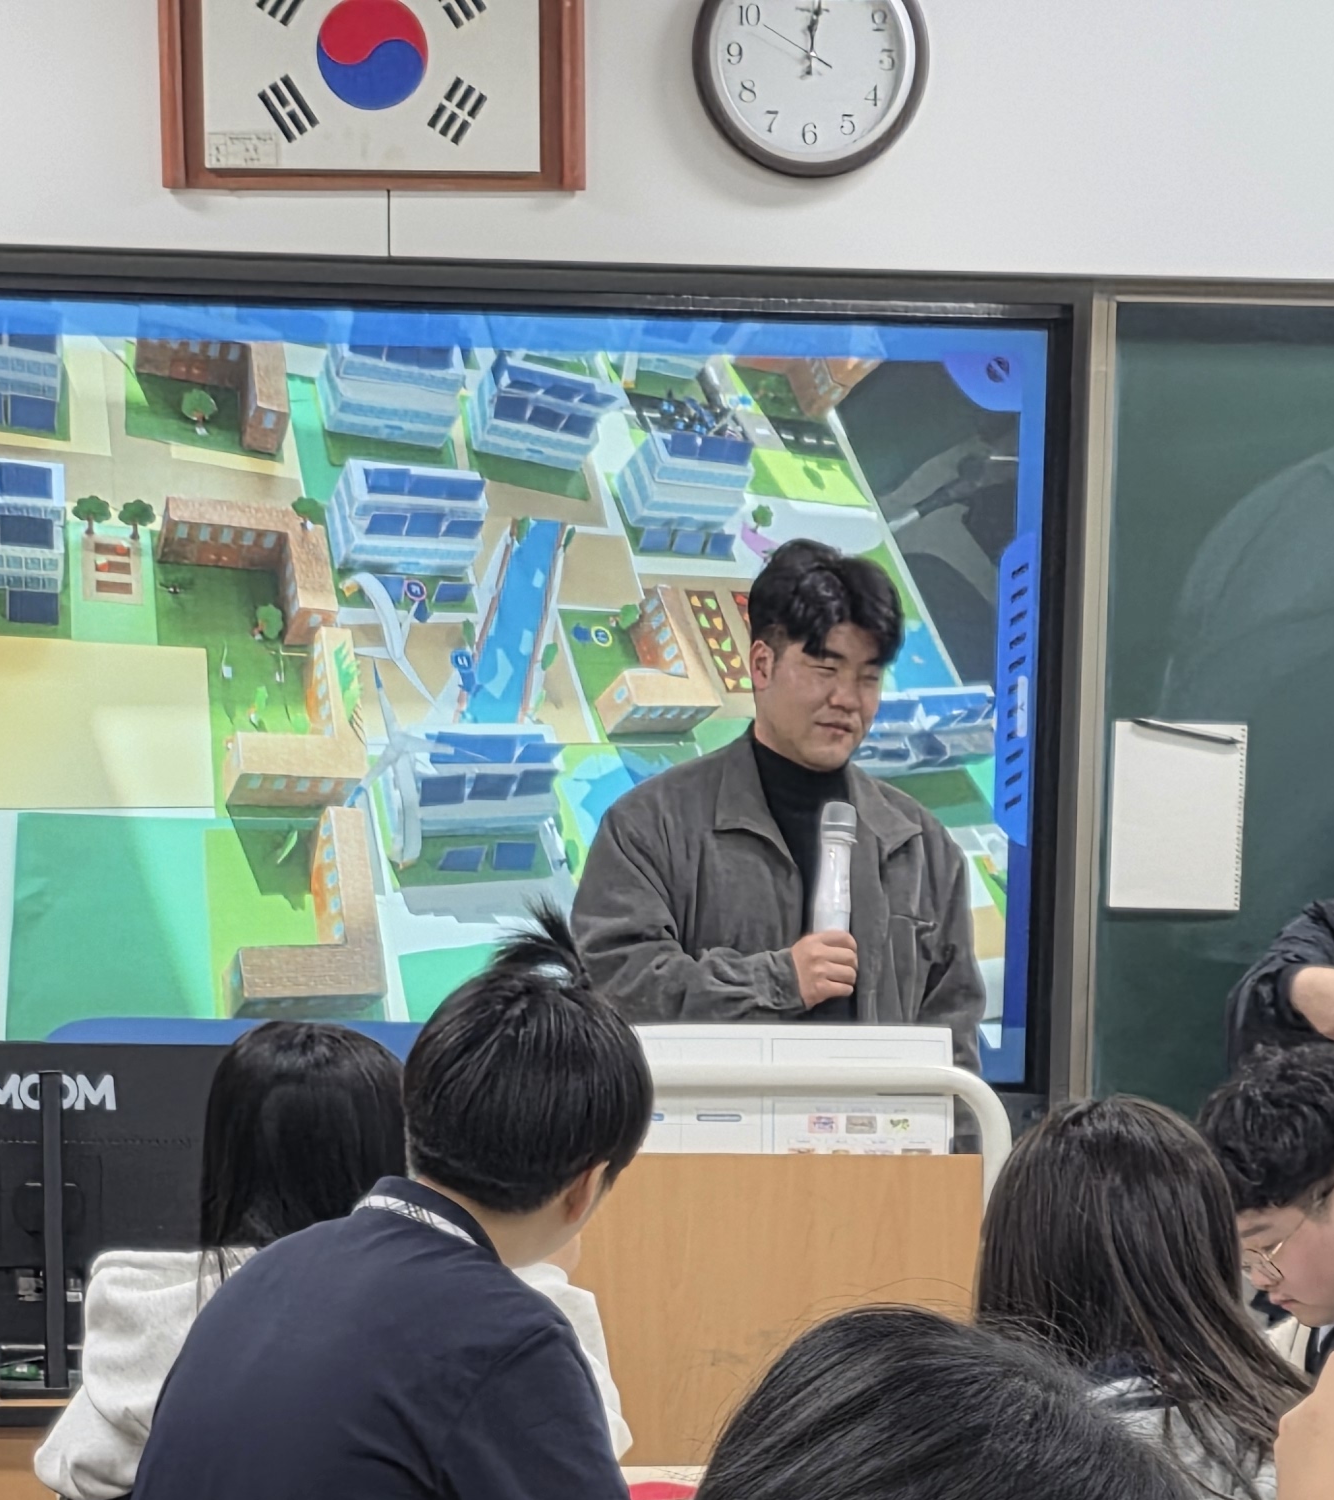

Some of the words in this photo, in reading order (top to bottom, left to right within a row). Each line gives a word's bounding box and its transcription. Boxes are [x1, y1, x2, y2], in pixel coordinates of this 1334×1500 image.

[738, 3, 761, 27] 10
[726, 41, 743, 65] 9
[738, 79, 757, 103] 8
[864, 84, 880, 107] 4
[765, 110, 779, 133] 7
[840, 113, 856, 135] 5
[801, 122, 818, 145] 6
